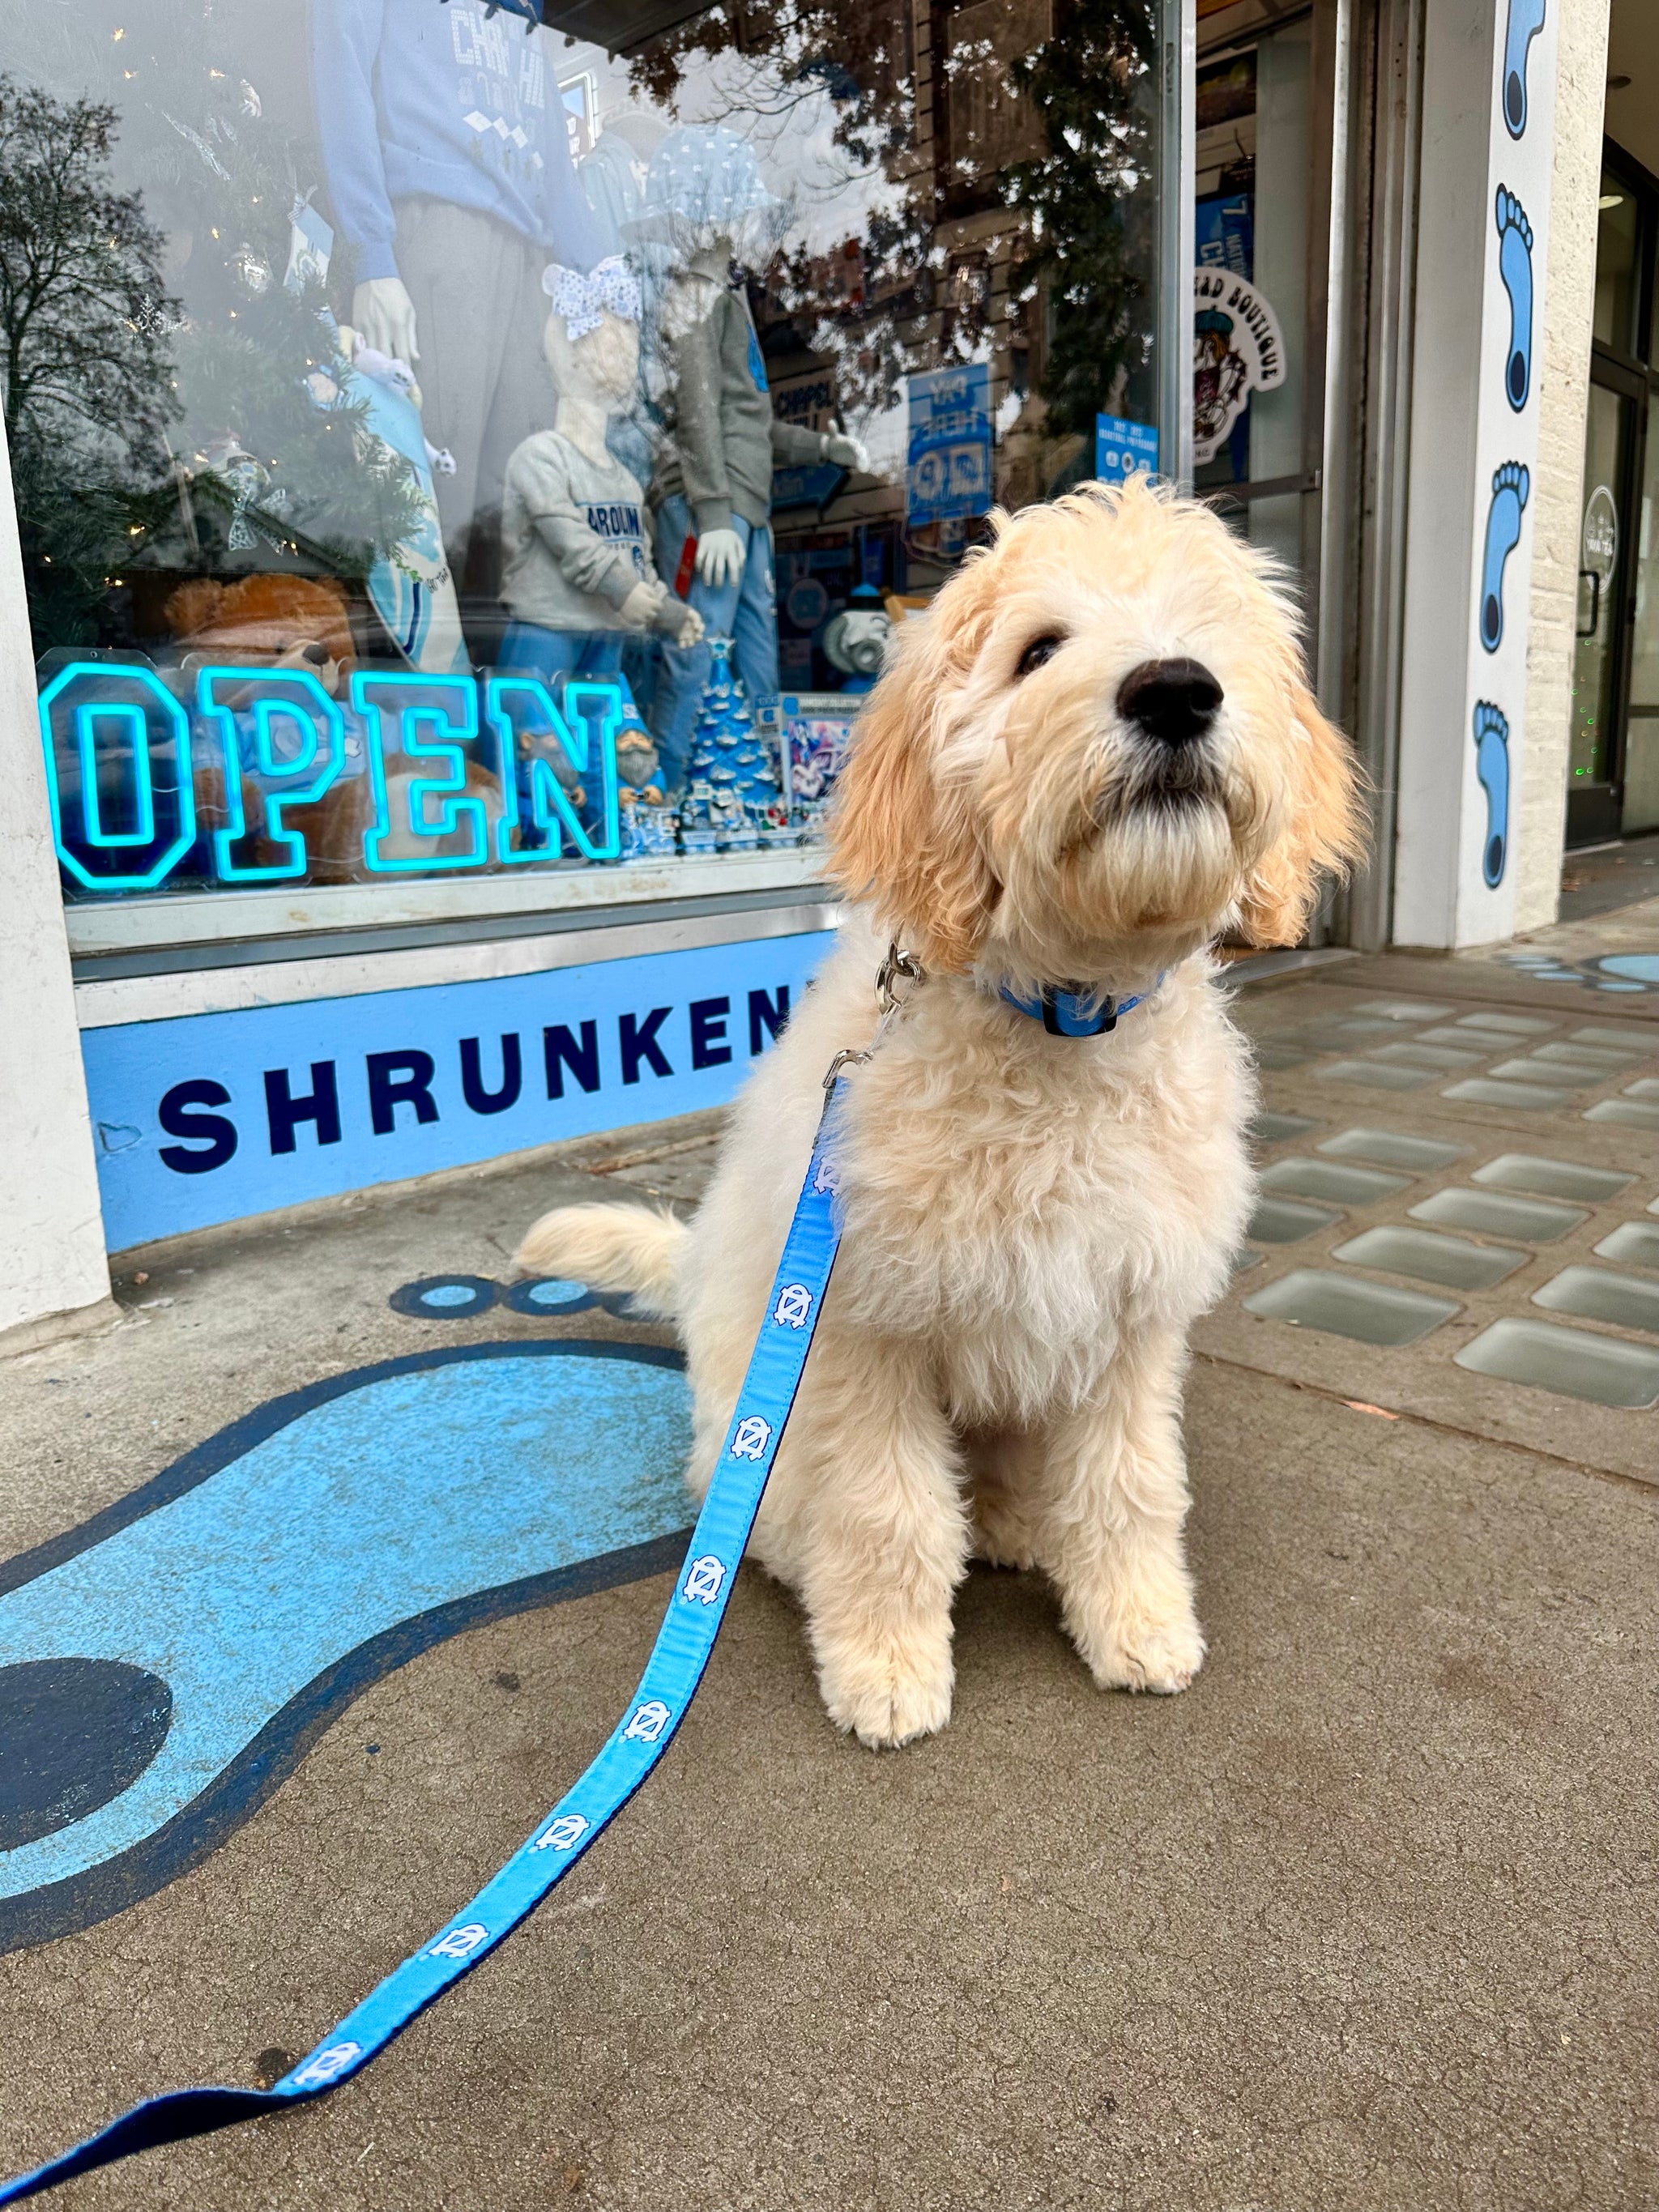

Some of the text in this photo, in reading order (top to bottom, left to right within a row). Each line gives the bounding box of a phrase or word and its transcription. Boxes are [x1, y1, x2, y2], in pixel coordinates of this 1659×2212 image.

[1226, 286, 1279, 381] BOUTIQUE
[587, 506, 639, 536] AROLIN
[39, 663, 623, 888] OPEN
[159, 985, 790, 1175] SHRUNKEN
